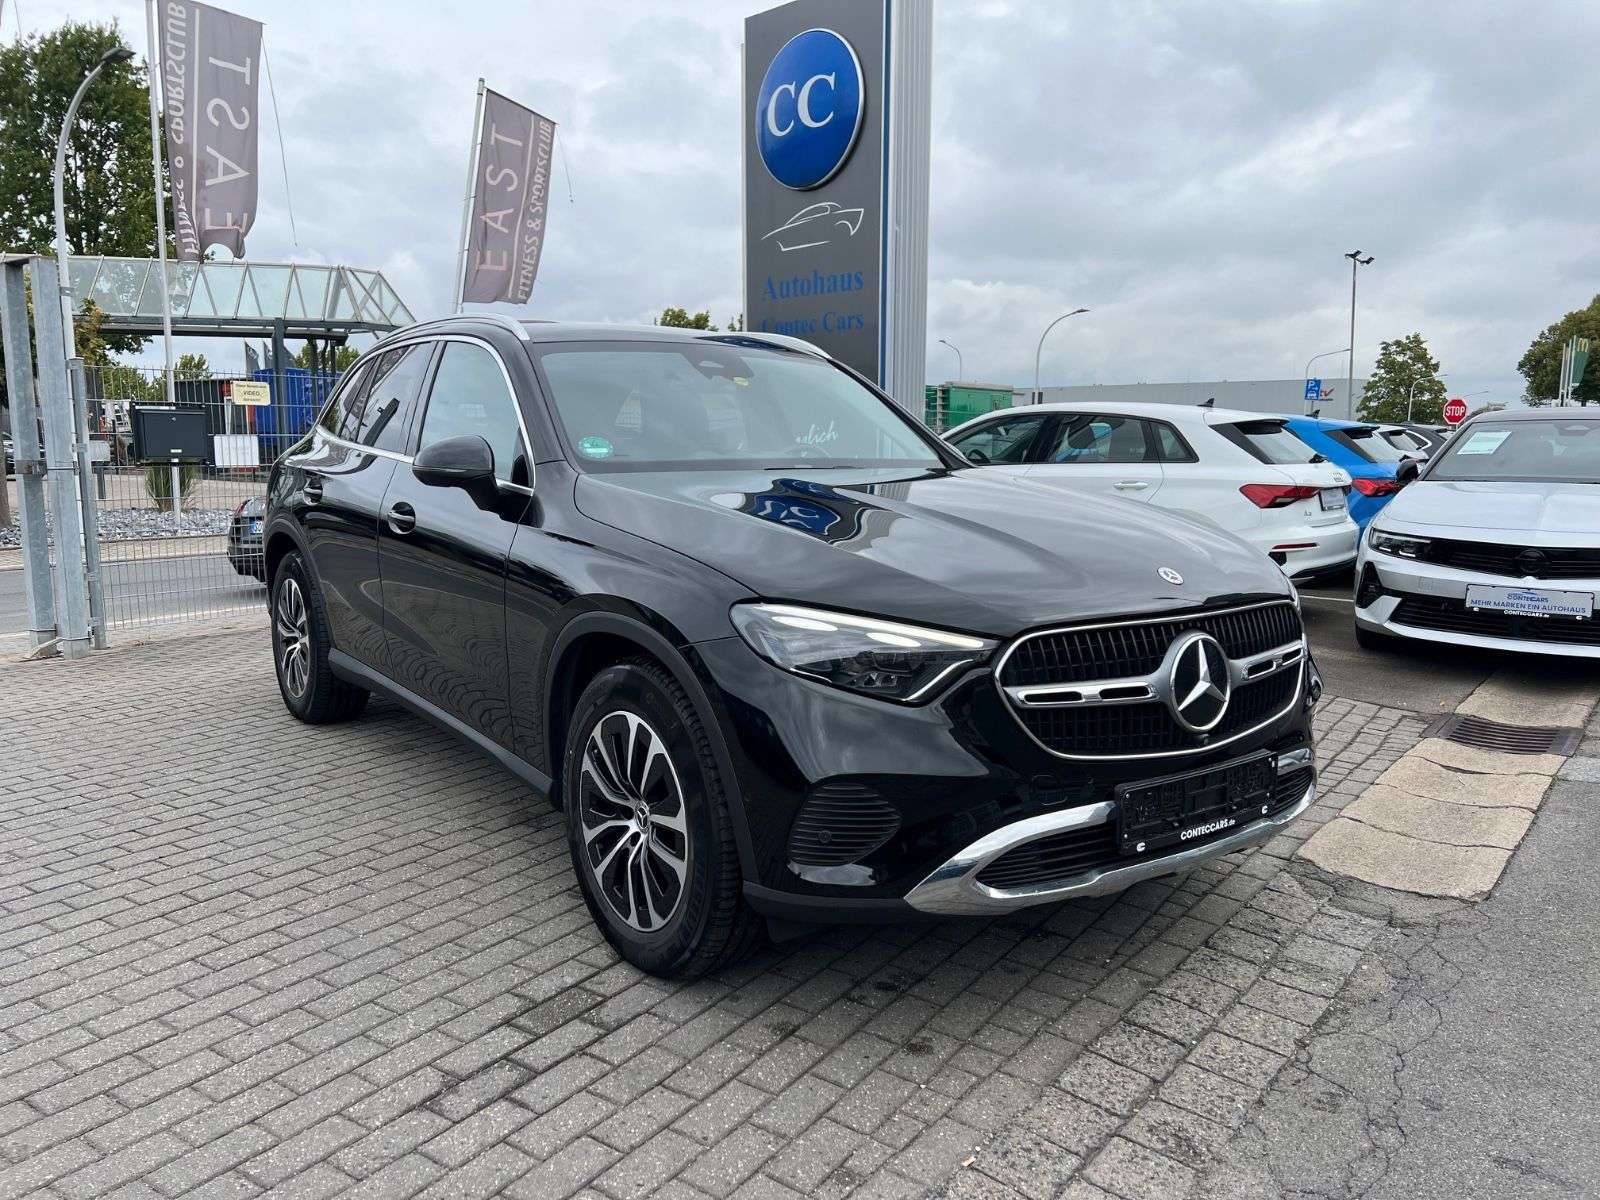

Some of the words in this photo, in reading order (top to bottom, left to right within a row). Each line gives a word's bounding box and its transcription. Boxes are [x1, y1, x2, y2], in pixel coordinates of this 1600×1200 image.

[767, 72, 836, 137] CC
[475, 122, 523, 271] EAST
[517, 234, 539, 300] FITNESS
[529, 120, 553, 214] SPORTSCLUB
[760, 269, 864, 300] Autohaus
[820, 311, 864, 332] Cars
[1446, 406, 1465, 416] STOP
[1493, 602, 1526, 610] MARKEN
[1541, 605, 1586, 613] AUTOHAUS
